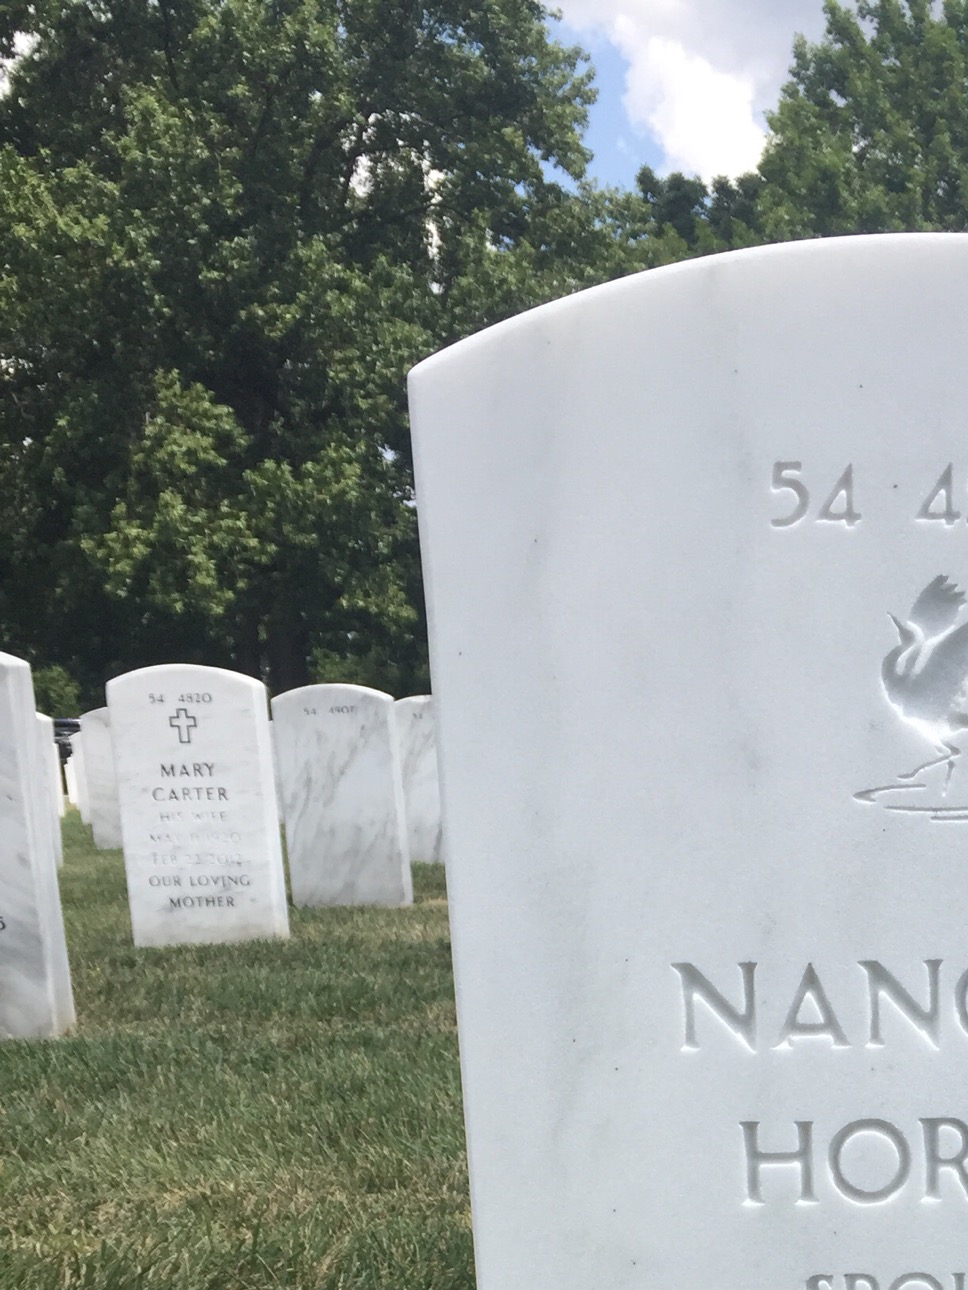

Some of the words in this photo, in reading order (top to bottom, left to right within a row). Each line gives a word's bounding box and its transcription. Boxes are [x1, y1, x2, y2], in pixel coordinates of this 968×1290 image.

[770, 460, 862, 528] 54
[160, 762, 215, 778] MARY
[151, 786, 229, 801] CARTER
[148, 874, 182, 887] OUR
[189, 874, 251, 888] LOVING
[168, 895, 236, 909] MOTHER
